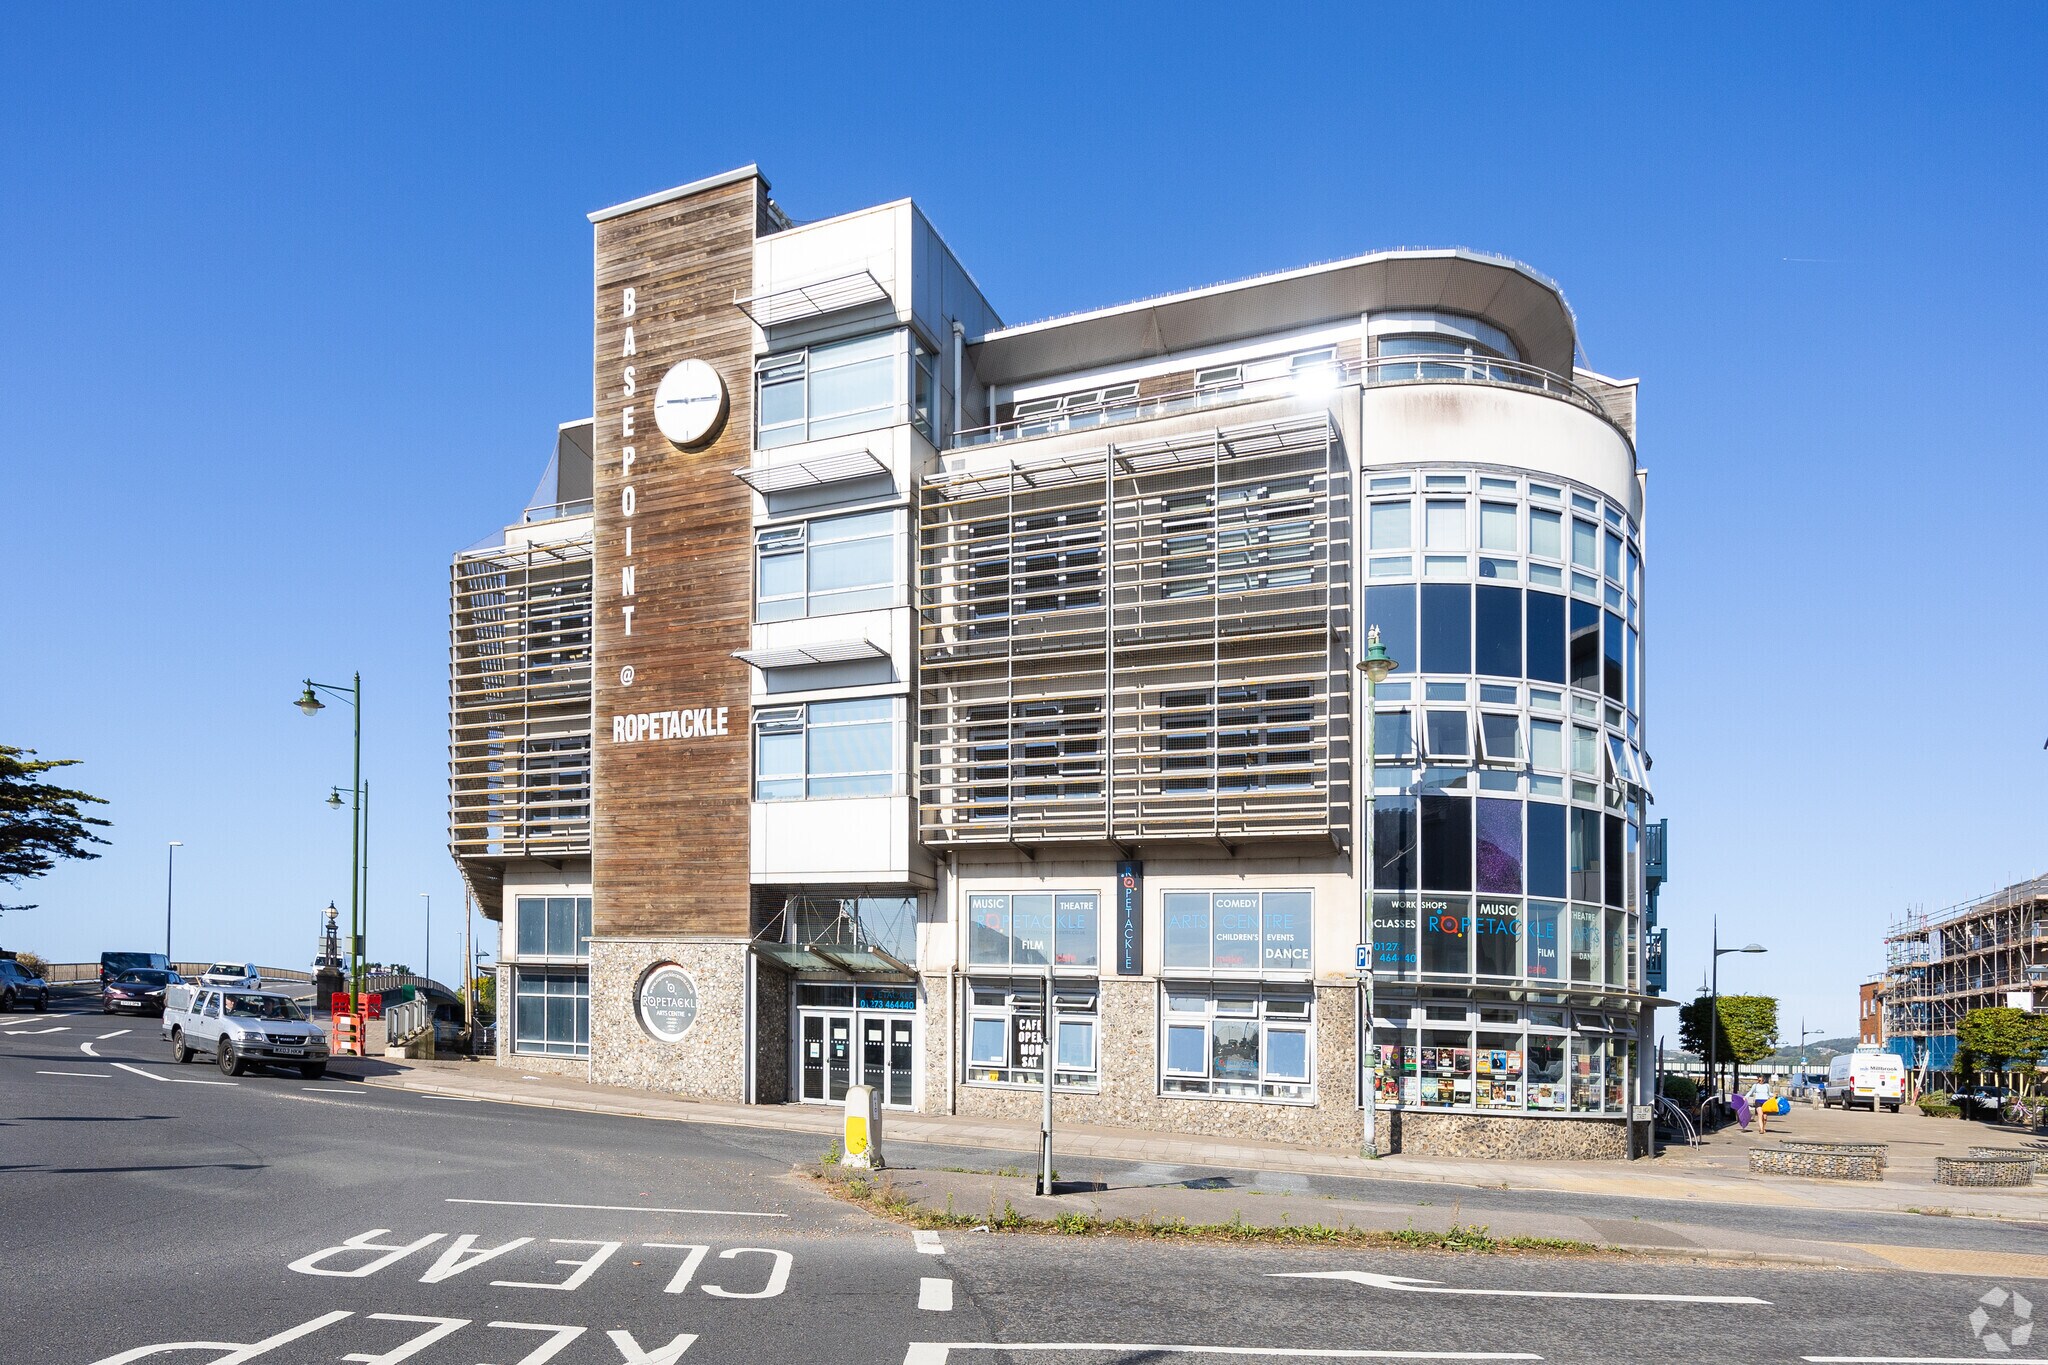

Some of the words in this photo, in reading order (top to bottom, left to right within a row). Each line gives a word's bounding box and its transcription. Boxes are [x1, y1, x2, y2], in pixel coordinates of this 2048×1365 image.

[622, 287, 637, 636] BASEPOINT
[620, 665, 635, 687] @
[612, 706, 729, 743] ROPETACKLE
[972, 899, 1005, 909] MUSIC
[1060, 902, 1094, 910] THEATRE
[1216, 899, 1258, 908] COMEDY
[1480, 903, 1518, 916] MUSIC
[976, 913, 1086, 929] ROPETACKLE
[1123, 867, 1135, 969] ROPETACKLE
[1168, 914, 1208, 929] ARTS
[1222, 914, 1294, 929] CENTRE
[1571, 910, 1595, 921] THEATRE
[1374, 919, 1416, 928] CLASSES
[1429, 915, 1554, 939] ROPETACKLE
[1216, 933, 1259, 941] CHILDREN'S
[1266, 933, 1295, 942] EVENTS
[1021, 940, 1044, 950] FILM
[1265, 948, 1309, 959] DANCE
[1537, 948, 1555, 958] FILM
[860, 1000, 883, 1009] 01273
[885, 1001, 915, 1010] 464440
[1018, 1018, 1042, 1031] CAFE
[1018, 1031, 1044, 1044] OPEN
[1021, 1056, 1039, 1068] SAT
[287, 1228, 795, 1299] CLEAR
